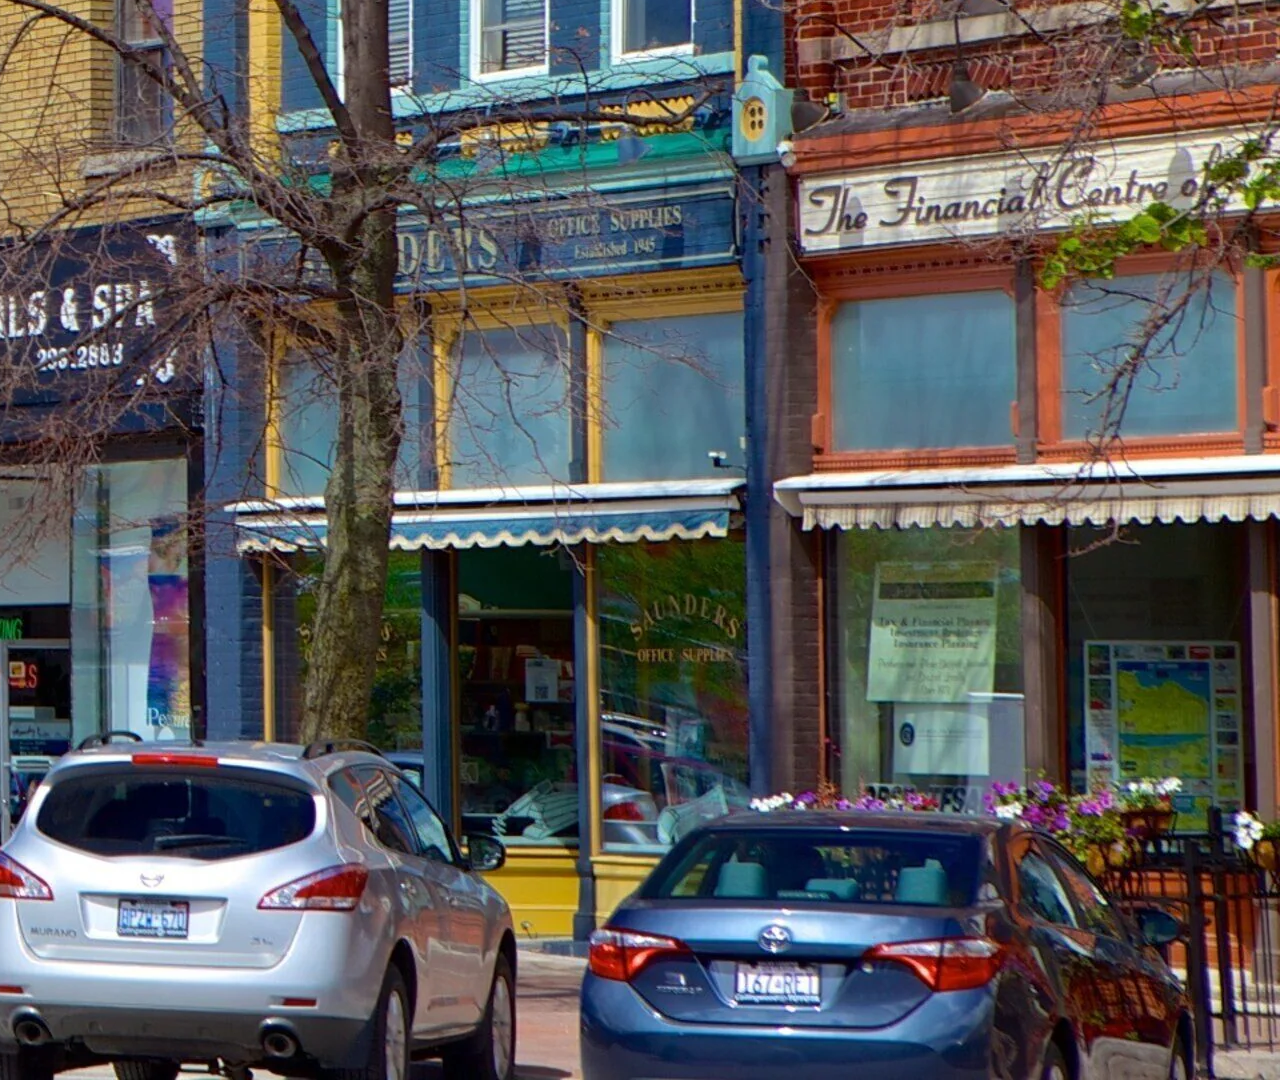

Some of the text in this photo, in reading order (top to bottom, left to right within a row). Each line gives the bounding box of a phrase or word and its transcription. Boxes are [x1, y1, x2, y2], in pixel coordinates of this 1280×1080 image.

[805, 184, 867, 236] The
[878, 161, 1049, 227] Financial
[1056, 156, 1168, 211] Centre
[549, 205, 682, 236] OFFICE SUPPLIES
[59, 286, 81, 332] &
[92, 280, 157, 329] SPA
[630, 593, 740, 641] SAUNDERS
[636, 648, 674, 662] OFFICE
[30, 926, 77, 938] MURANO
